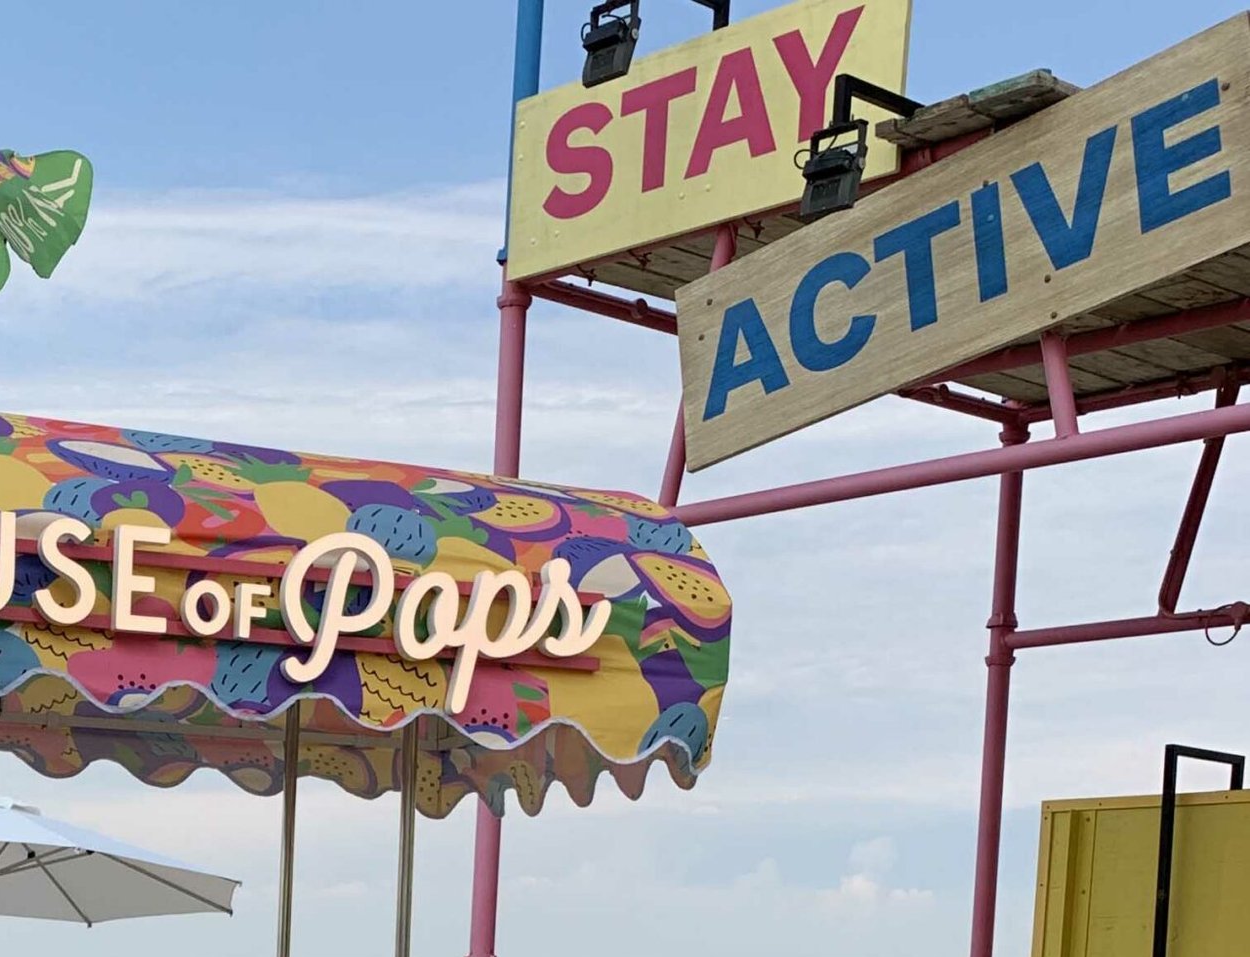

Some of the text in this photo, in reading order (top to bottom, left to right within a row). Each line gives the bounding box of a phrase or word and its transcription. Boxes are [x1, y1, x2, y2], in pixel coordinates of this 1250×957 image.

[542, 6, 865, 219] STAY
[702, 77, 1232, 422] ACTIVE
[180, 580, 271, 639] OF
[280, 532, 611, 714] Pops
